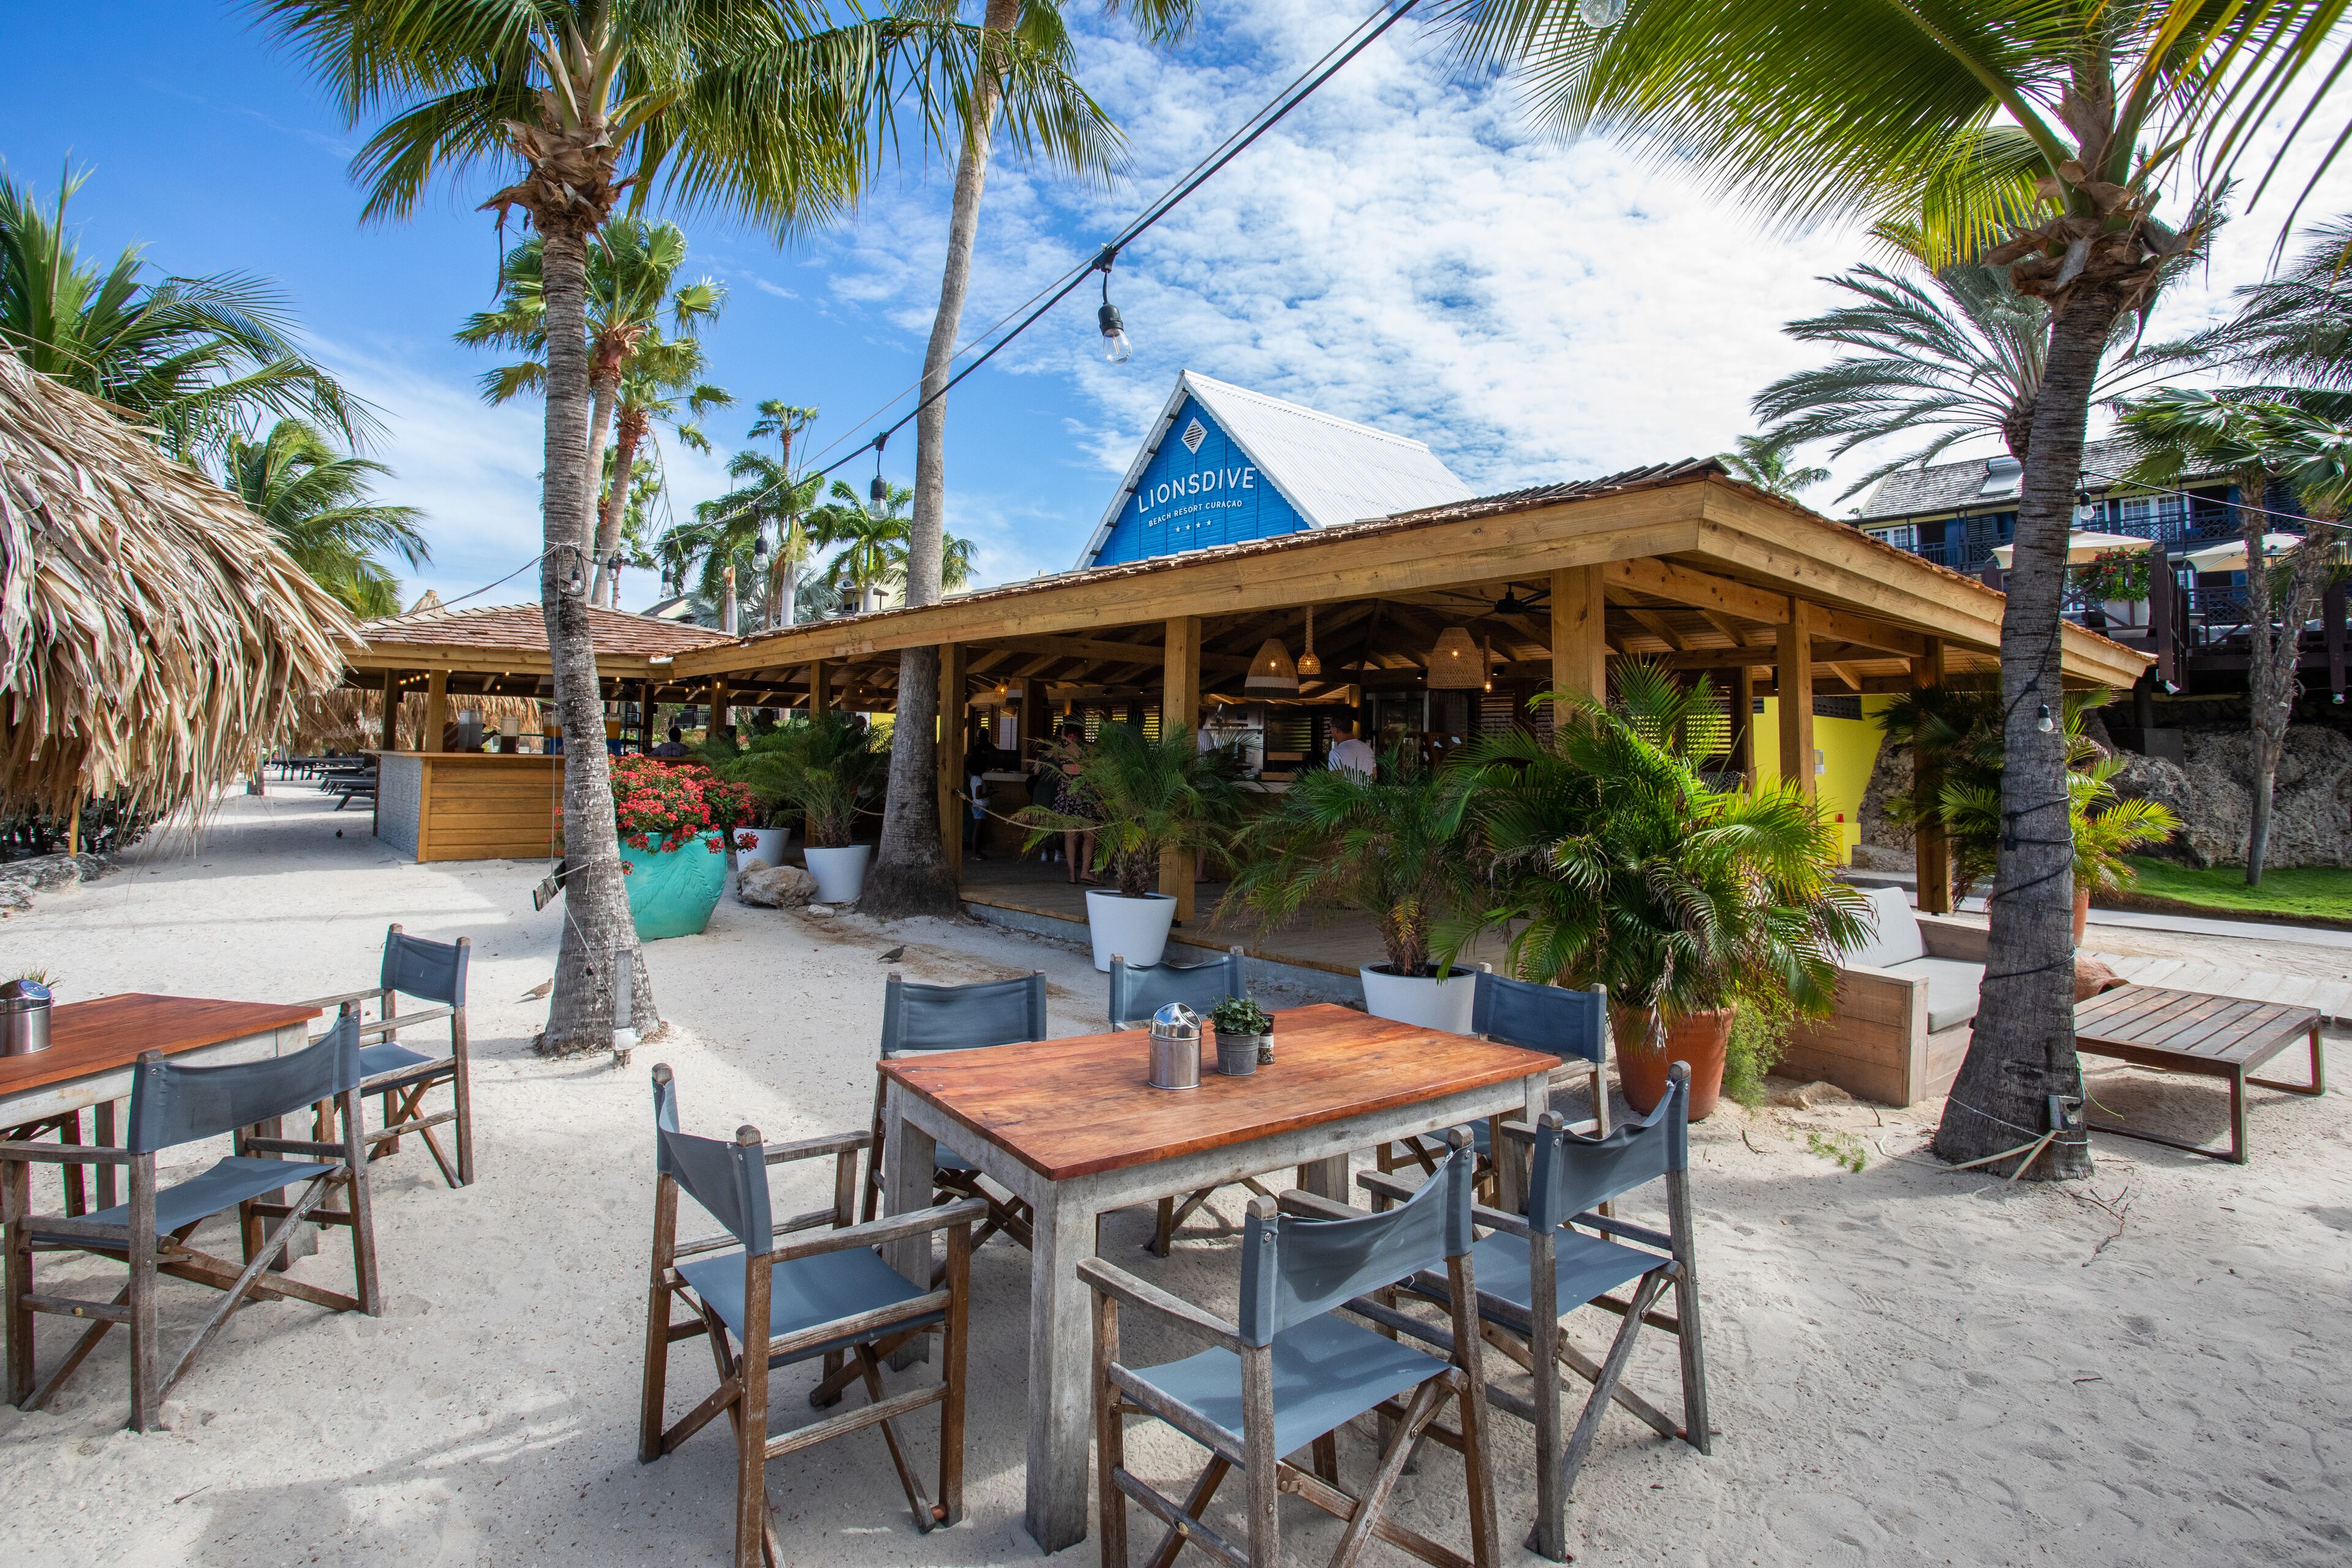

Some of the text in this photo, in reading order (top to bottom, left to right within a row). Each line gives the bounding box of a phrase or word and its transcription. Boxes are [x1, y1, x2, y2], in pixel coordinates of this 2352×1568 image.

[1138, 467, 1256, 513] LIONSDIVE
[1148, 500, 1242, 527] BEACH RESORT CURAÇAO
